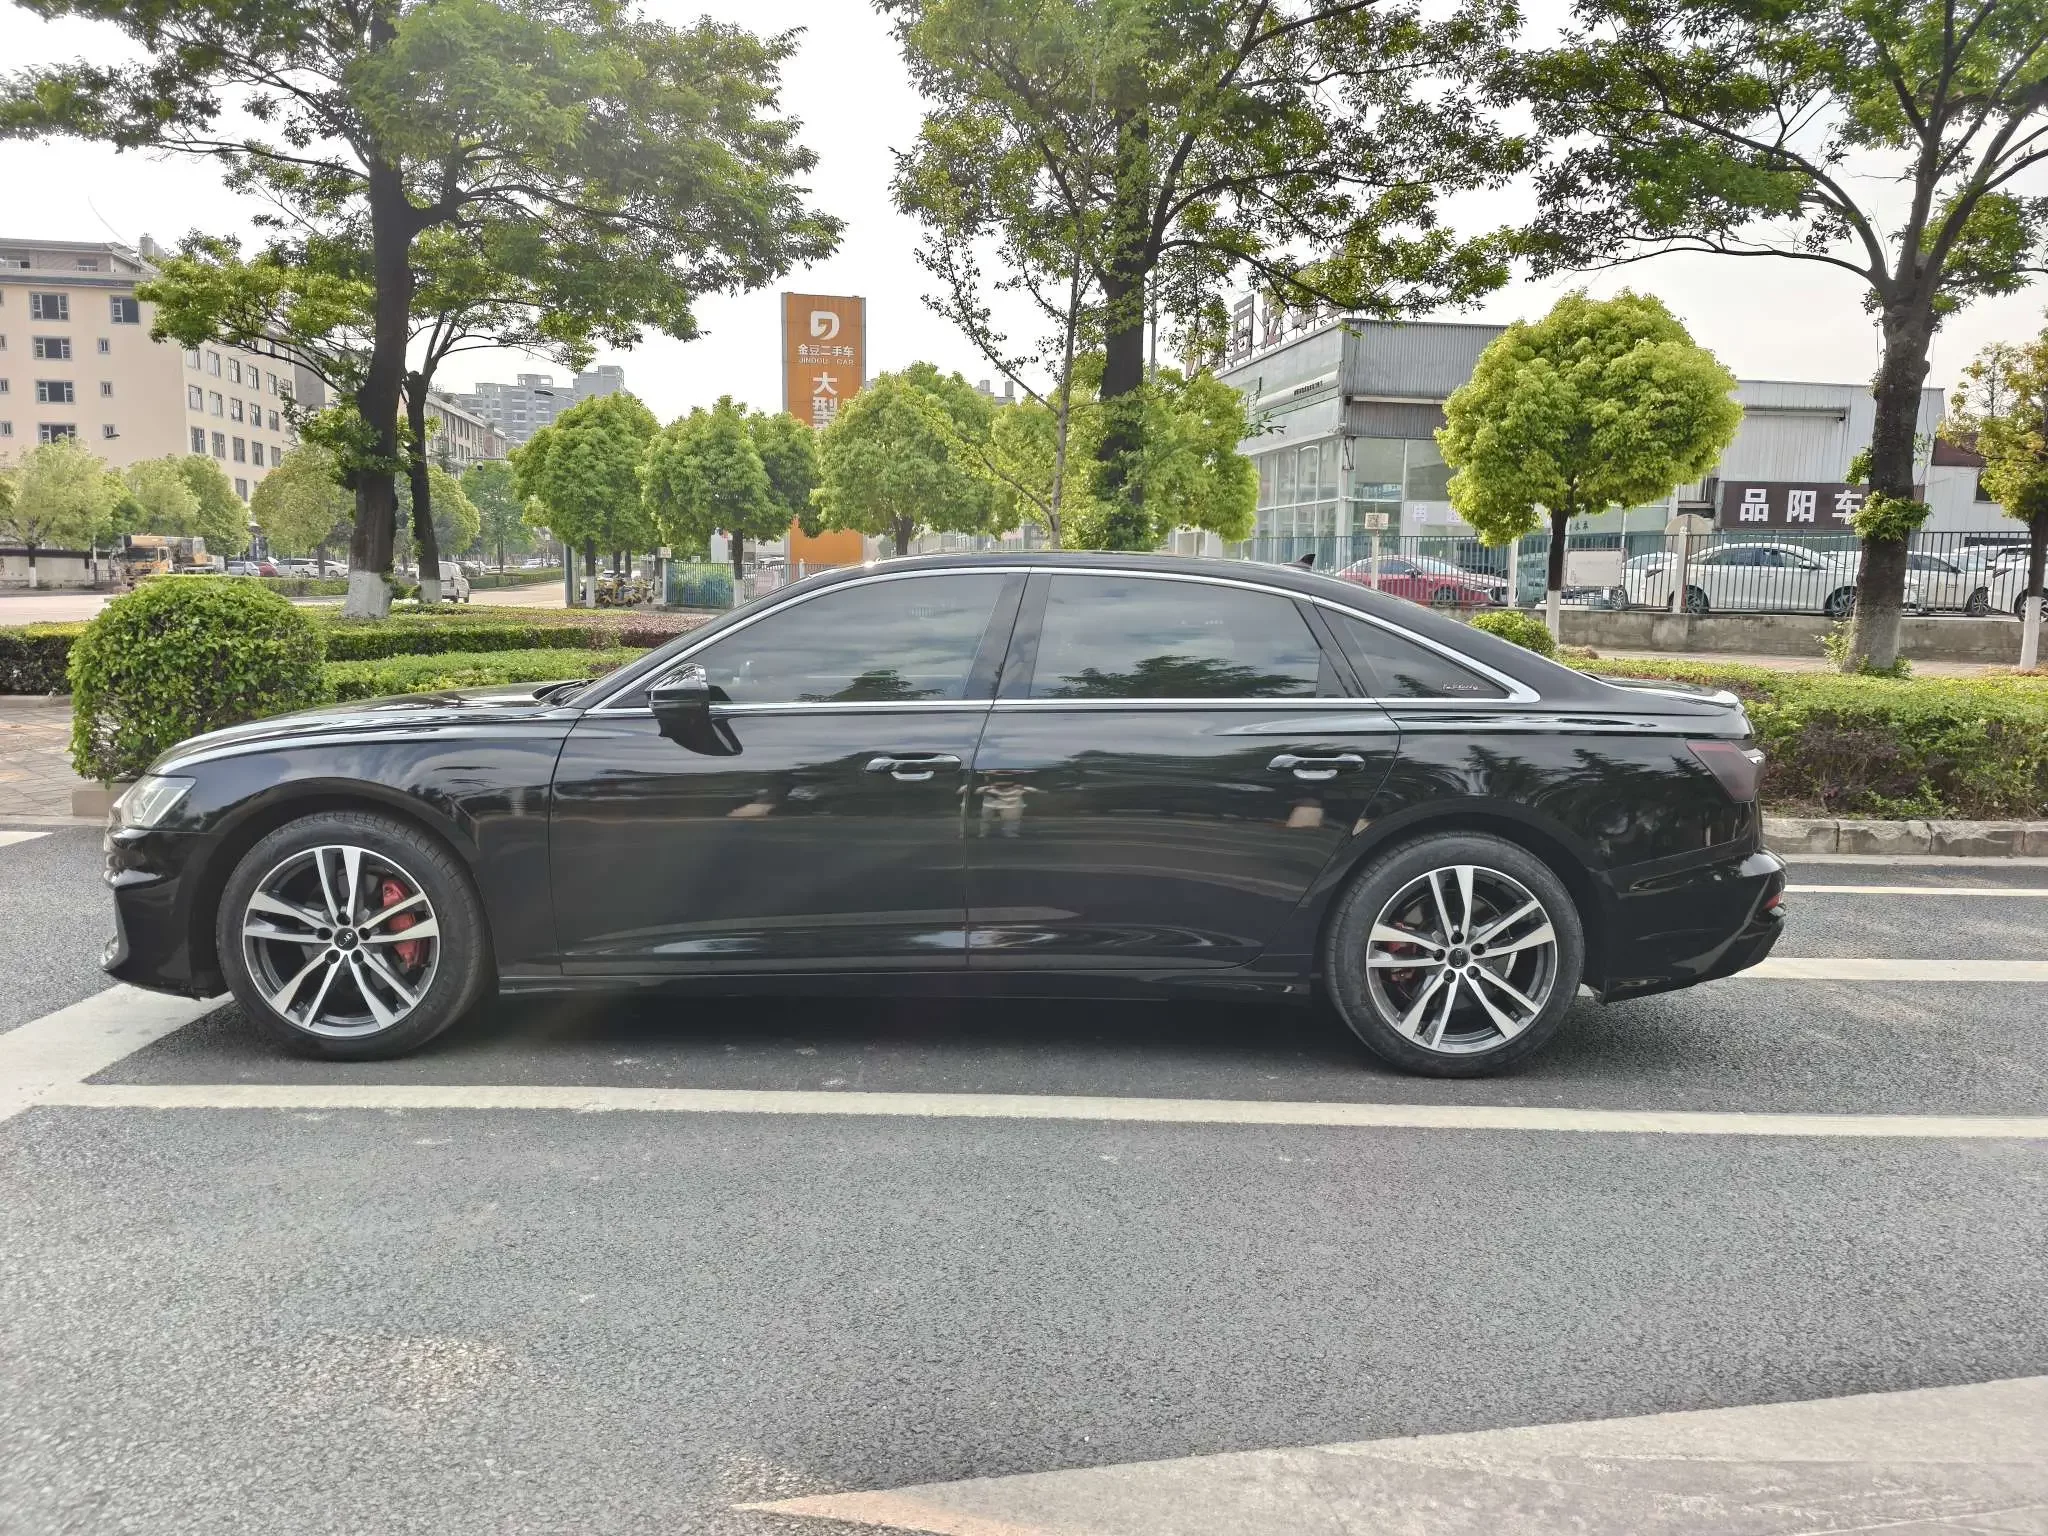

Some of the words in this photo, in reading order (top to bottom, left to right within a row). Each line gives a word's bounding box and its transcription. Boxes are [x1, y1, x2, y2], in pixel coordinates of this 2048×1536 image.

[798, 344, 855, 358] 金豆二手车
[799, 356, 829, 365] JINDOU
[812, 371, 838, 430] 大型
[1739, 488, 1863, 525] 品阳车
